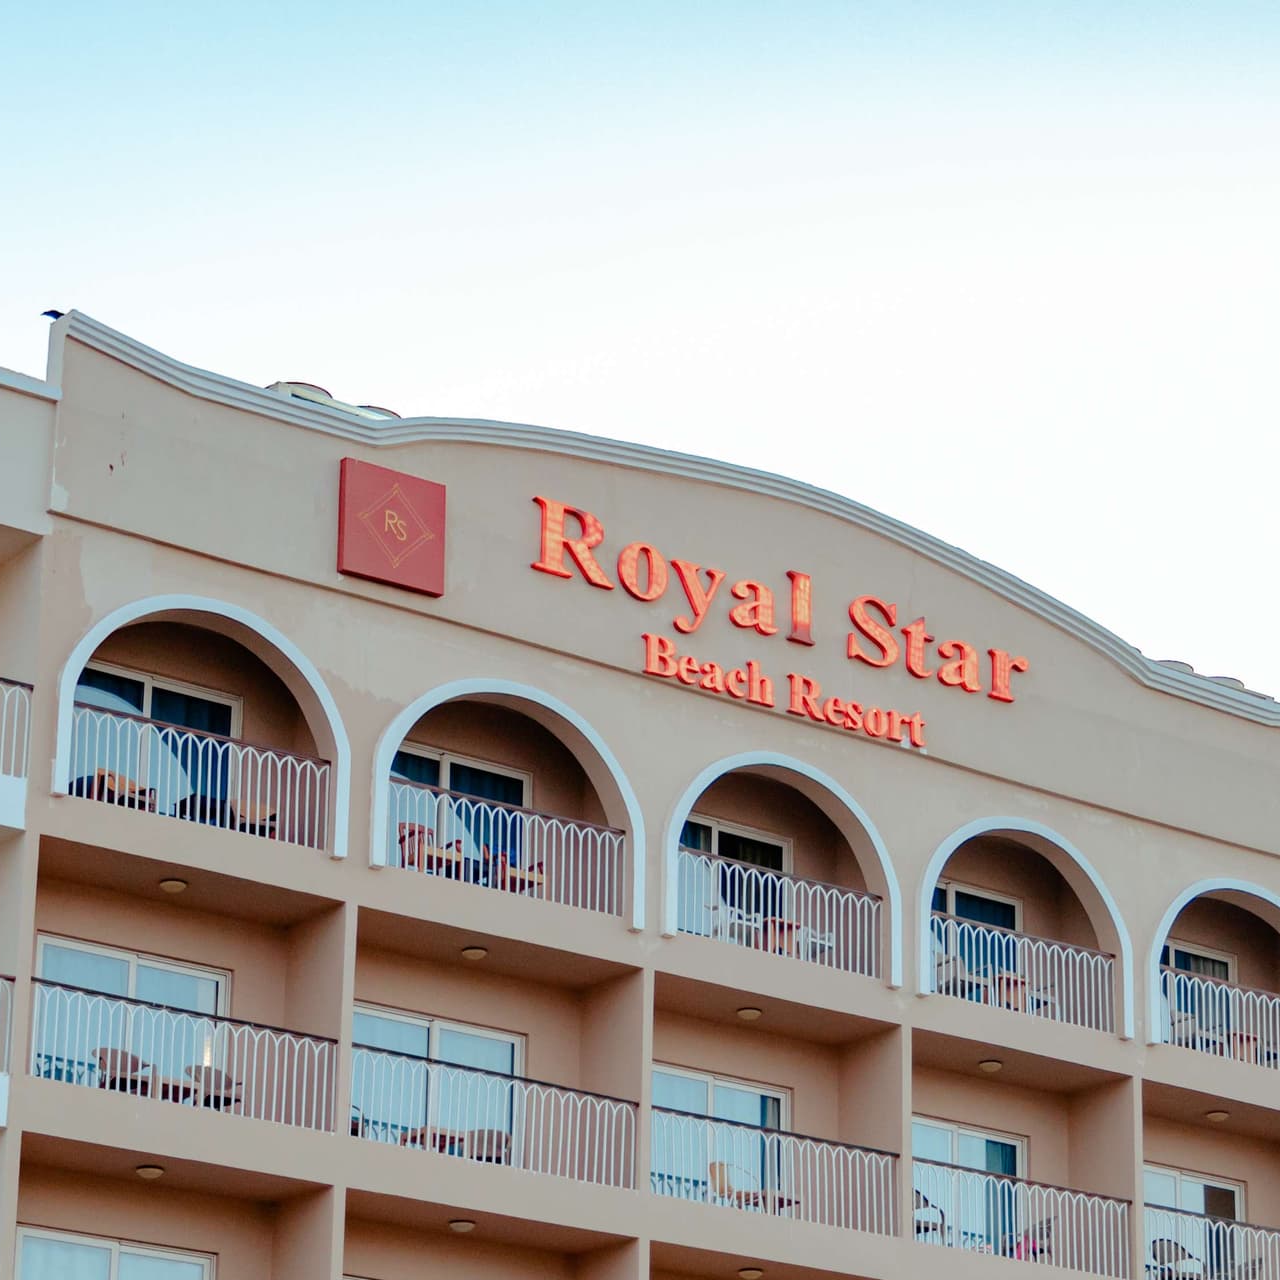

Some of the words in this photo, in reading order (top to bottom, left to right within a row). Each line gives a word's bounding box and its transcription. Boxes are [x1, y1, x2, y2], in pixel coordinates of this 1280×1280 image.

[384, 509, 407, 541] RS
[530, 495, 815, 647] Royal
[847, 594, 1029, 702] Star
[641, 632, 775, 707] Beach
[786, 672, 926, 747] Resort
